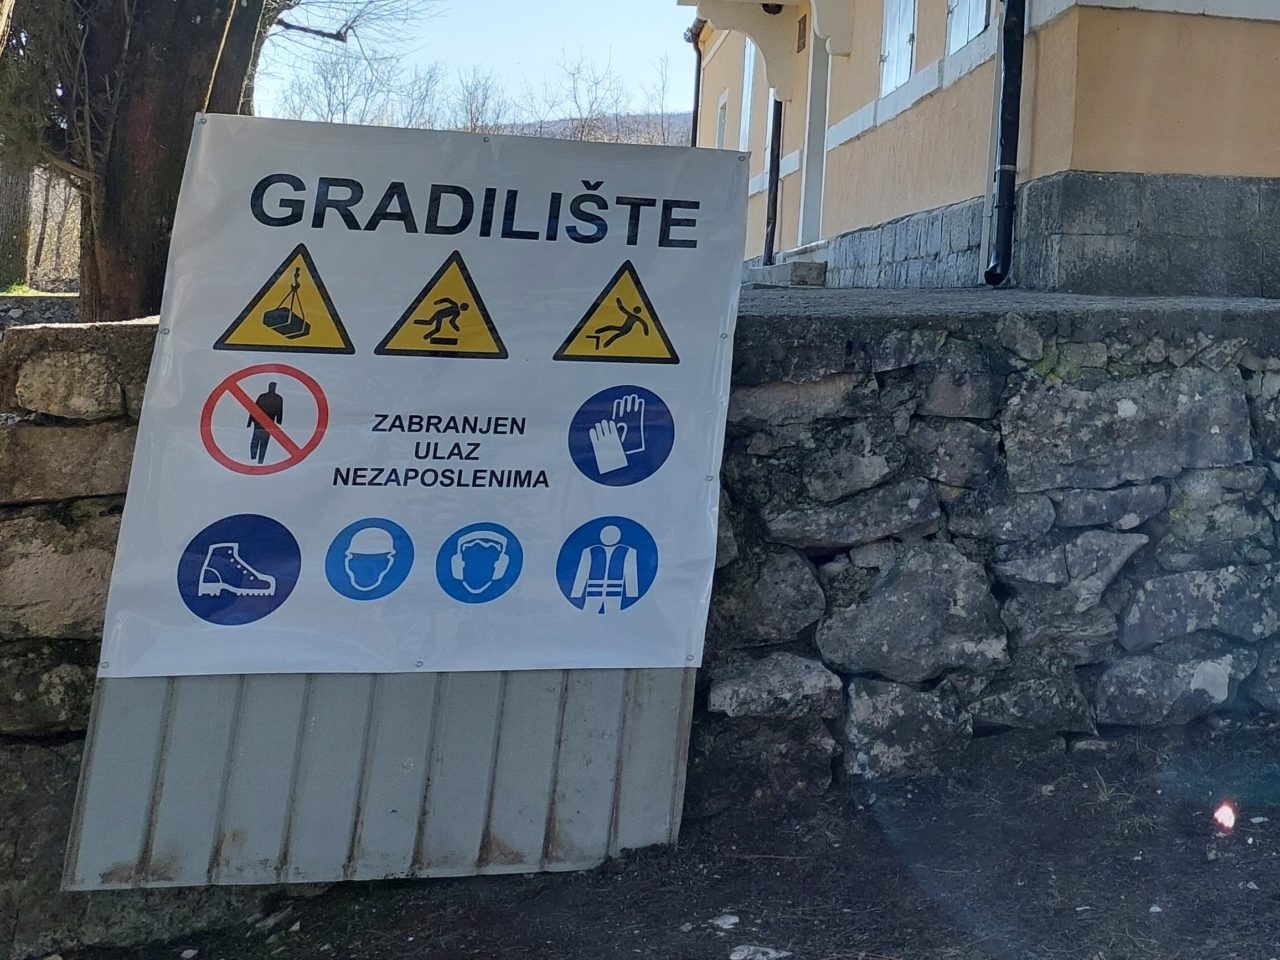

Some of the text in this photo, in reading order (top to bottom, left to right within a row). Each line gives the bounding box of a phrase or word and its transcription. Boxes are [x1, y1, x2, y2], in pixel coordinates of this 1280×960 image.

[250, 173, 701, 249] GRADILIŠTE
[371, 413, 527, 436] ZABRANJEN
[414, 441, 481, 461] ULAZ
[332, 467, 550, 489] NEZAPOSLENIMA
